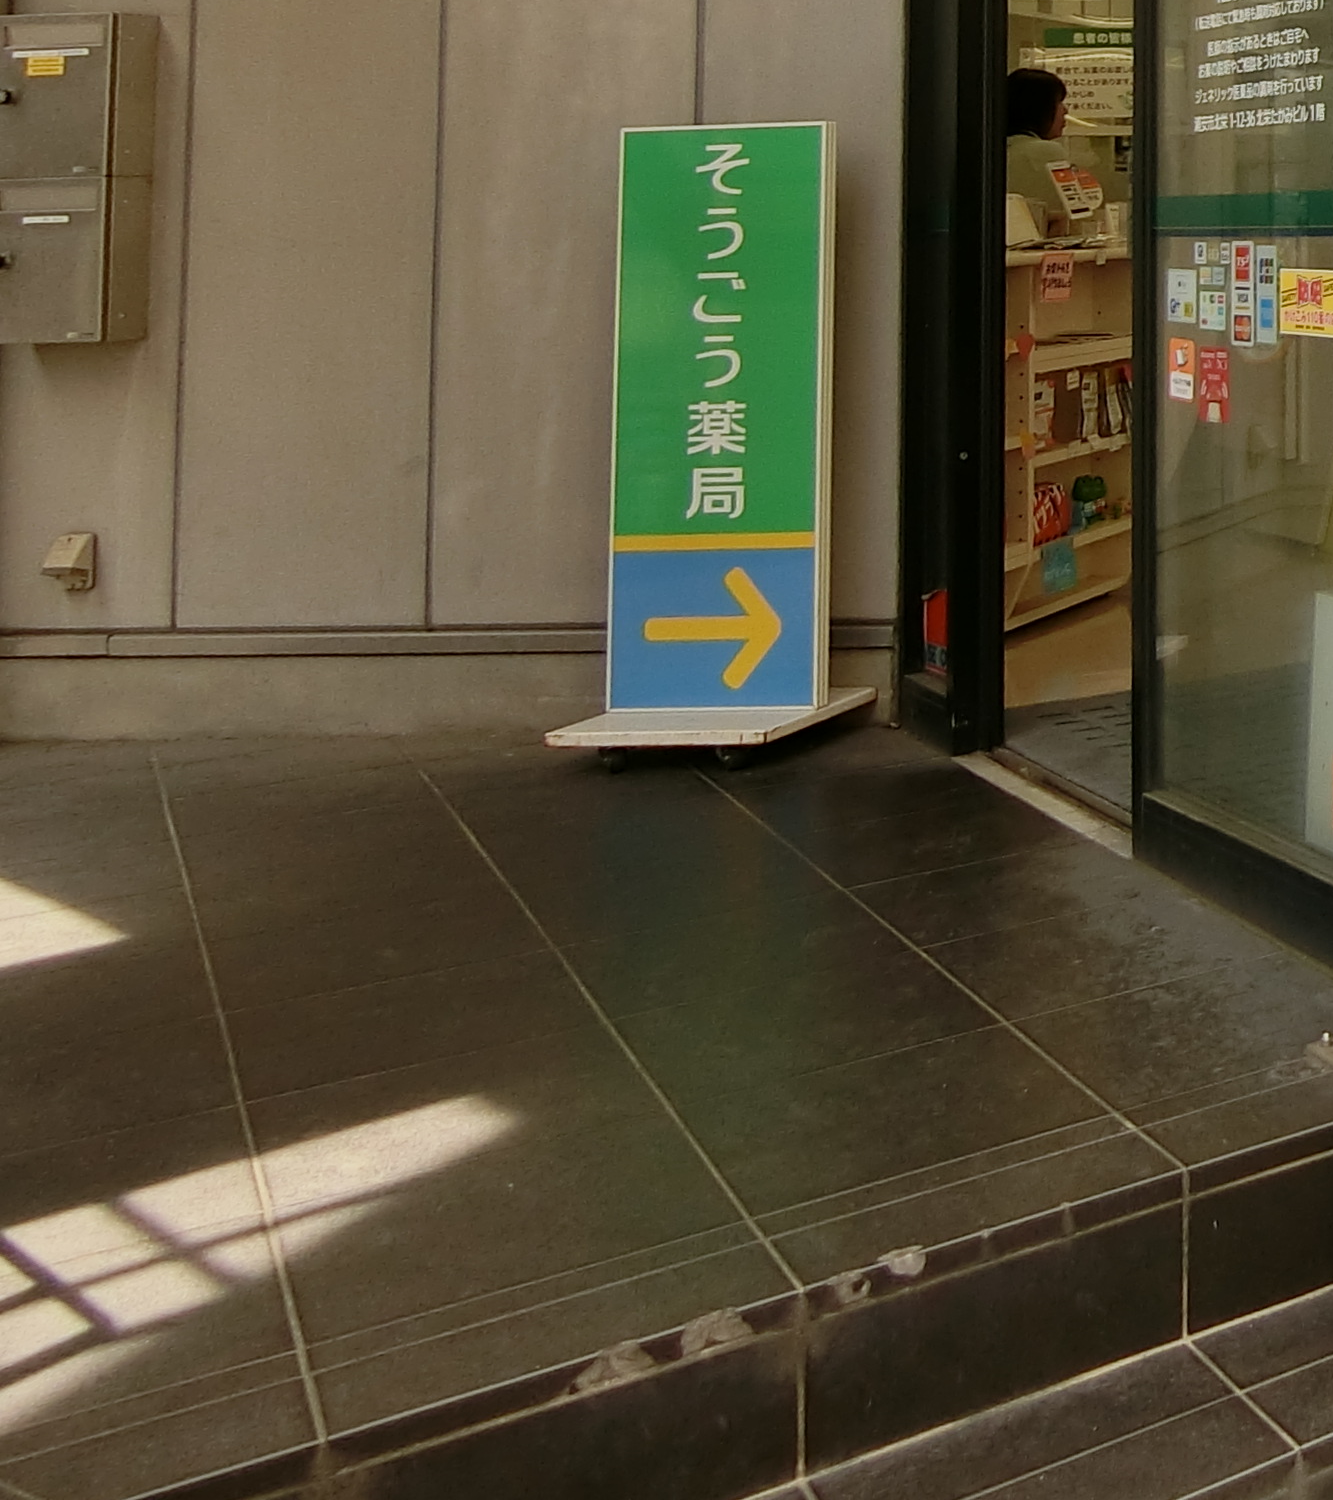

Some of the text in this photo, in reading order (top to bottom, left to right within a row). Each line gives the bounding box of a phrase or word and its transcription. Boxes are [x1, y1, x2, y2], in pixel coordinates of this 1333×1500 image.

[685, 143, 751, 521] そうごう薬局
